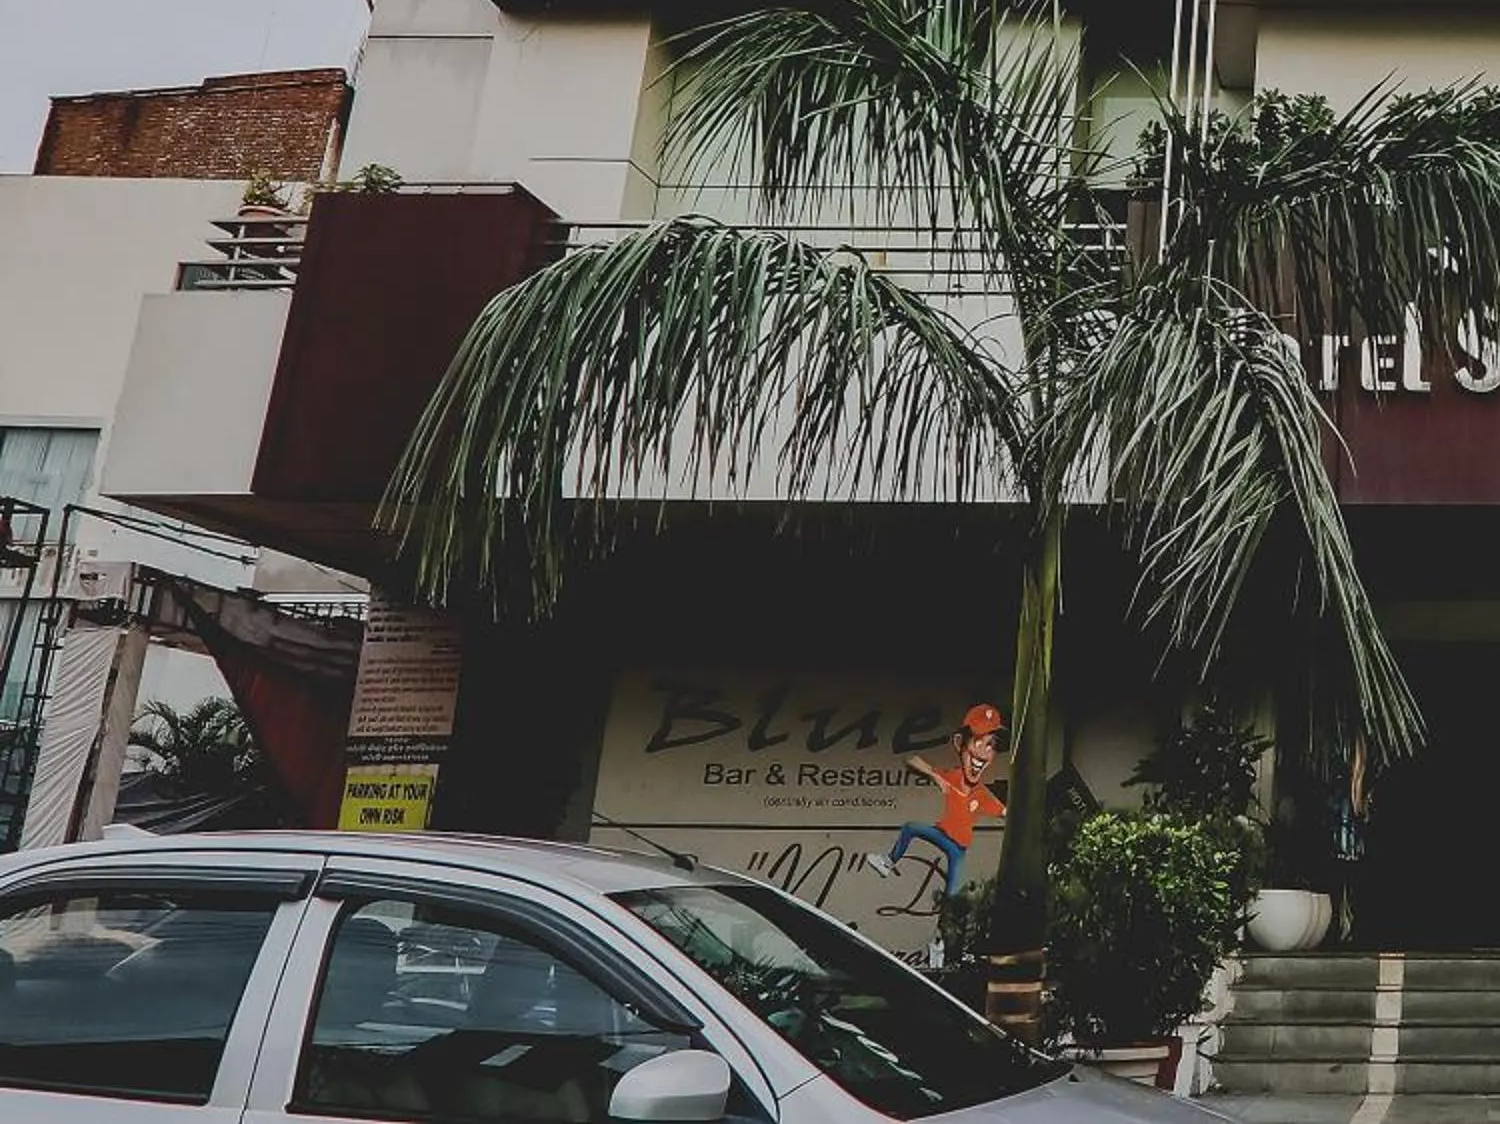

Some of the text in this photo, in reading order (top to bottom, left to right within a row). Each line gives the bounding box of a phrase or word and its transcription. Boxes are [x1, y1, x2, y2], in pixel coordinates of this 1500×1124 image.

[703, 763, 942, 787] Bar & Restaura
[387, 783, 401, 800] AT
